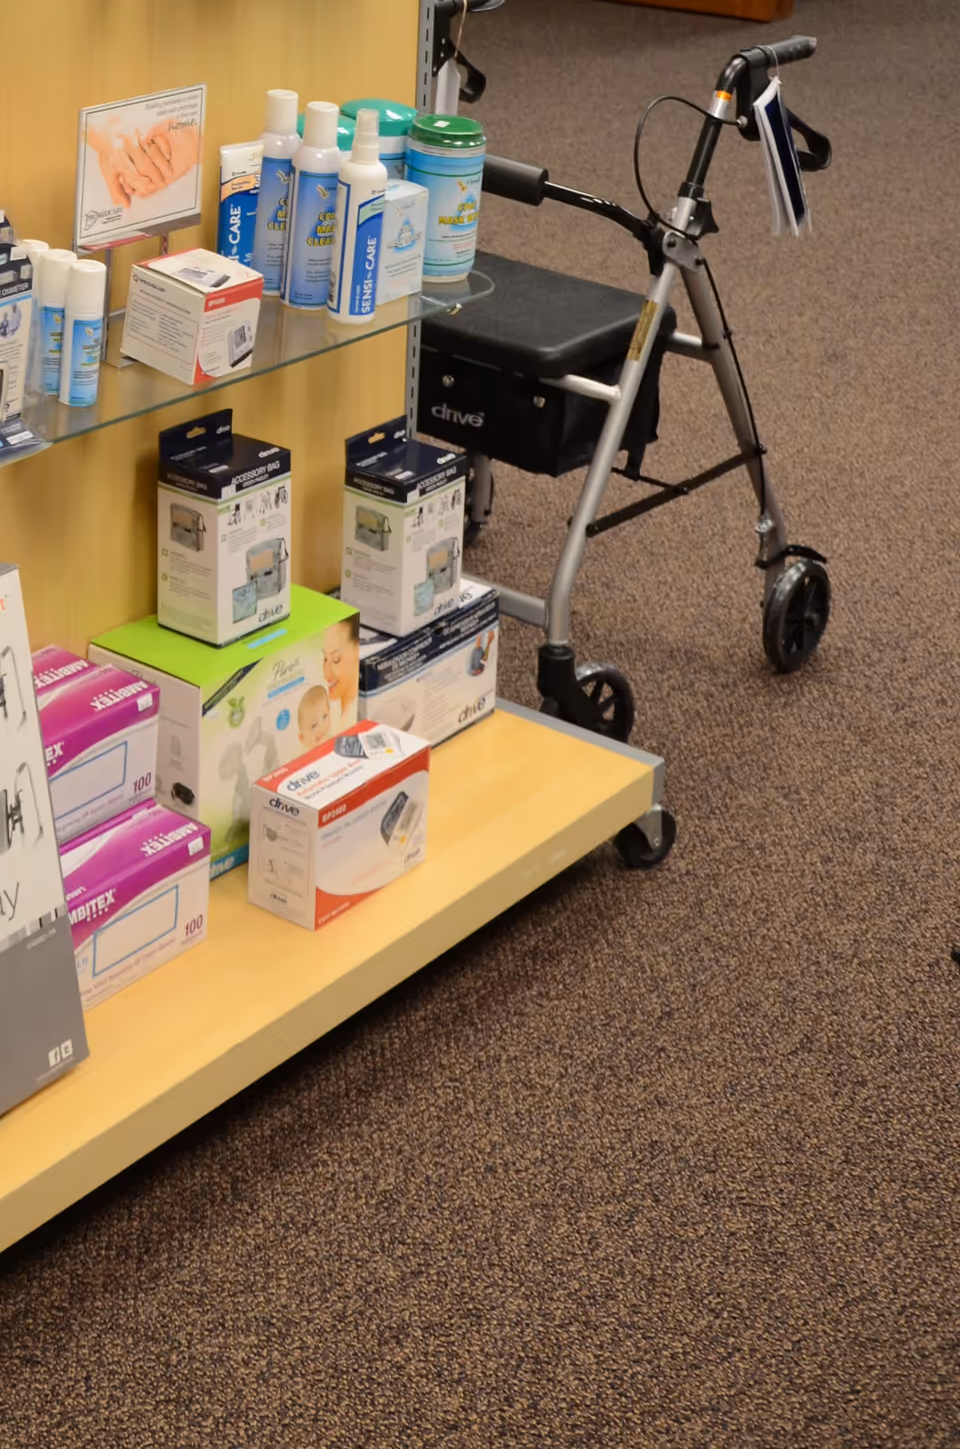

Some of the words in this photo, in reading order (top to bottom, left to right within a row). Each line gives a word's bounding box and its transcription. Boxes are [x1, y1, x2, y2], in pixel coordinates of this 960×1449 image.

[438, 215, 465, 225] MASK
[2, 282, 29, 295] OXIMETER
[431, 403, 483, 427] drive
[231, 464, 267, 484] ACCESSORY
[267, 460, 281, 472] BAG
[258, 604, 283, 623] drive
[434, 598, 455, 616] drive
[34, 659, 89, 689] AMBITEX
[90, 681, 148, 711] AMBITEX
[458, 697, 486, 723] drive
[134, 772, 152, 794] 100
[287, 770, 320, 792] drive
[269, 797, 300, 817] drive
[140, 822, 198, 857] AMBITEX
[185, 914, 203, 937] 100
